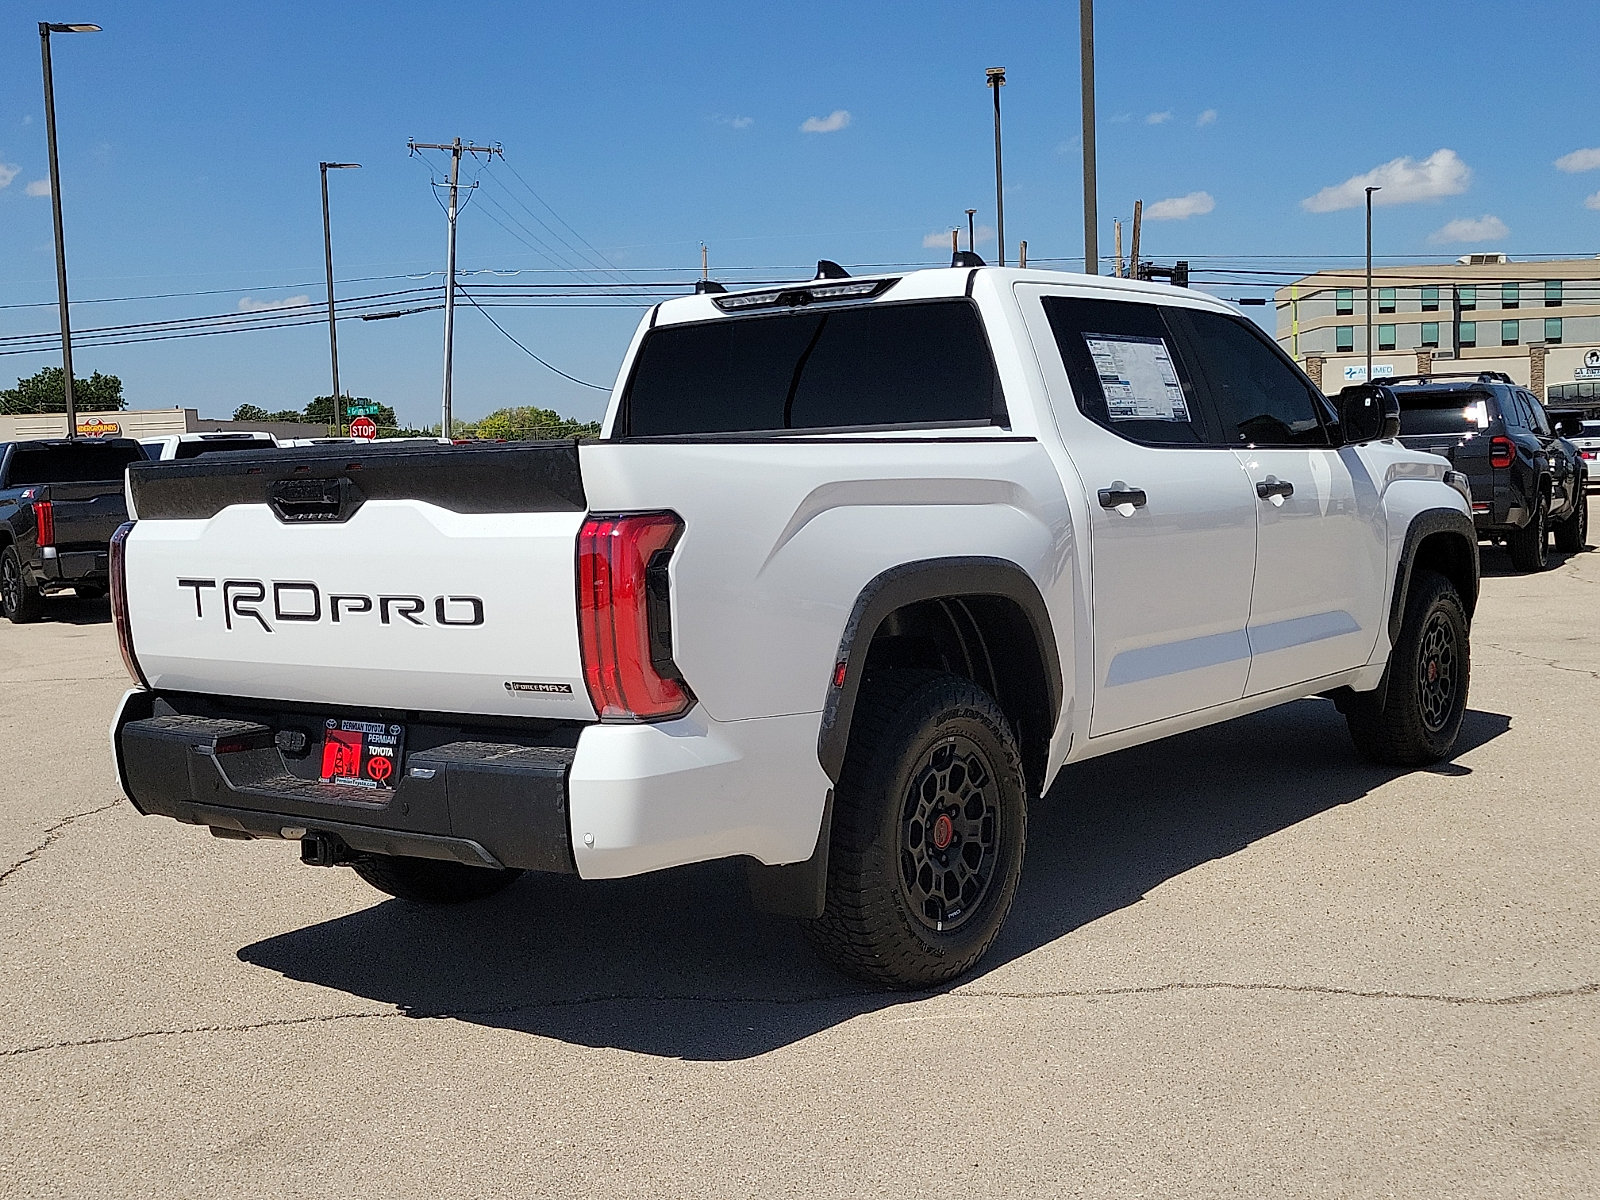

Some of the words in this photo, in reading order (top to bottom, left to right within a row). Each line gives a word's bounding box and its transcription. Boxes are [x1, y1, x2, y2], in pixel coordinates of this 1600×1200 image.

[1358, 366, 1392, 374] ALIMED
[78, 424, 116, 432] NDERGROUNDS
[352, 425, 374, 437] STOP
[177, 576, 322, 632] TRD
[328, 593, 485, 629] PRO
[343, 721, 364, 732] PERMIAN
[365, 723, 385, 733] TOYOTA
[368, 734, 396, 744] PERMIAN
[368, 746, 393, 757] TOYOTA
